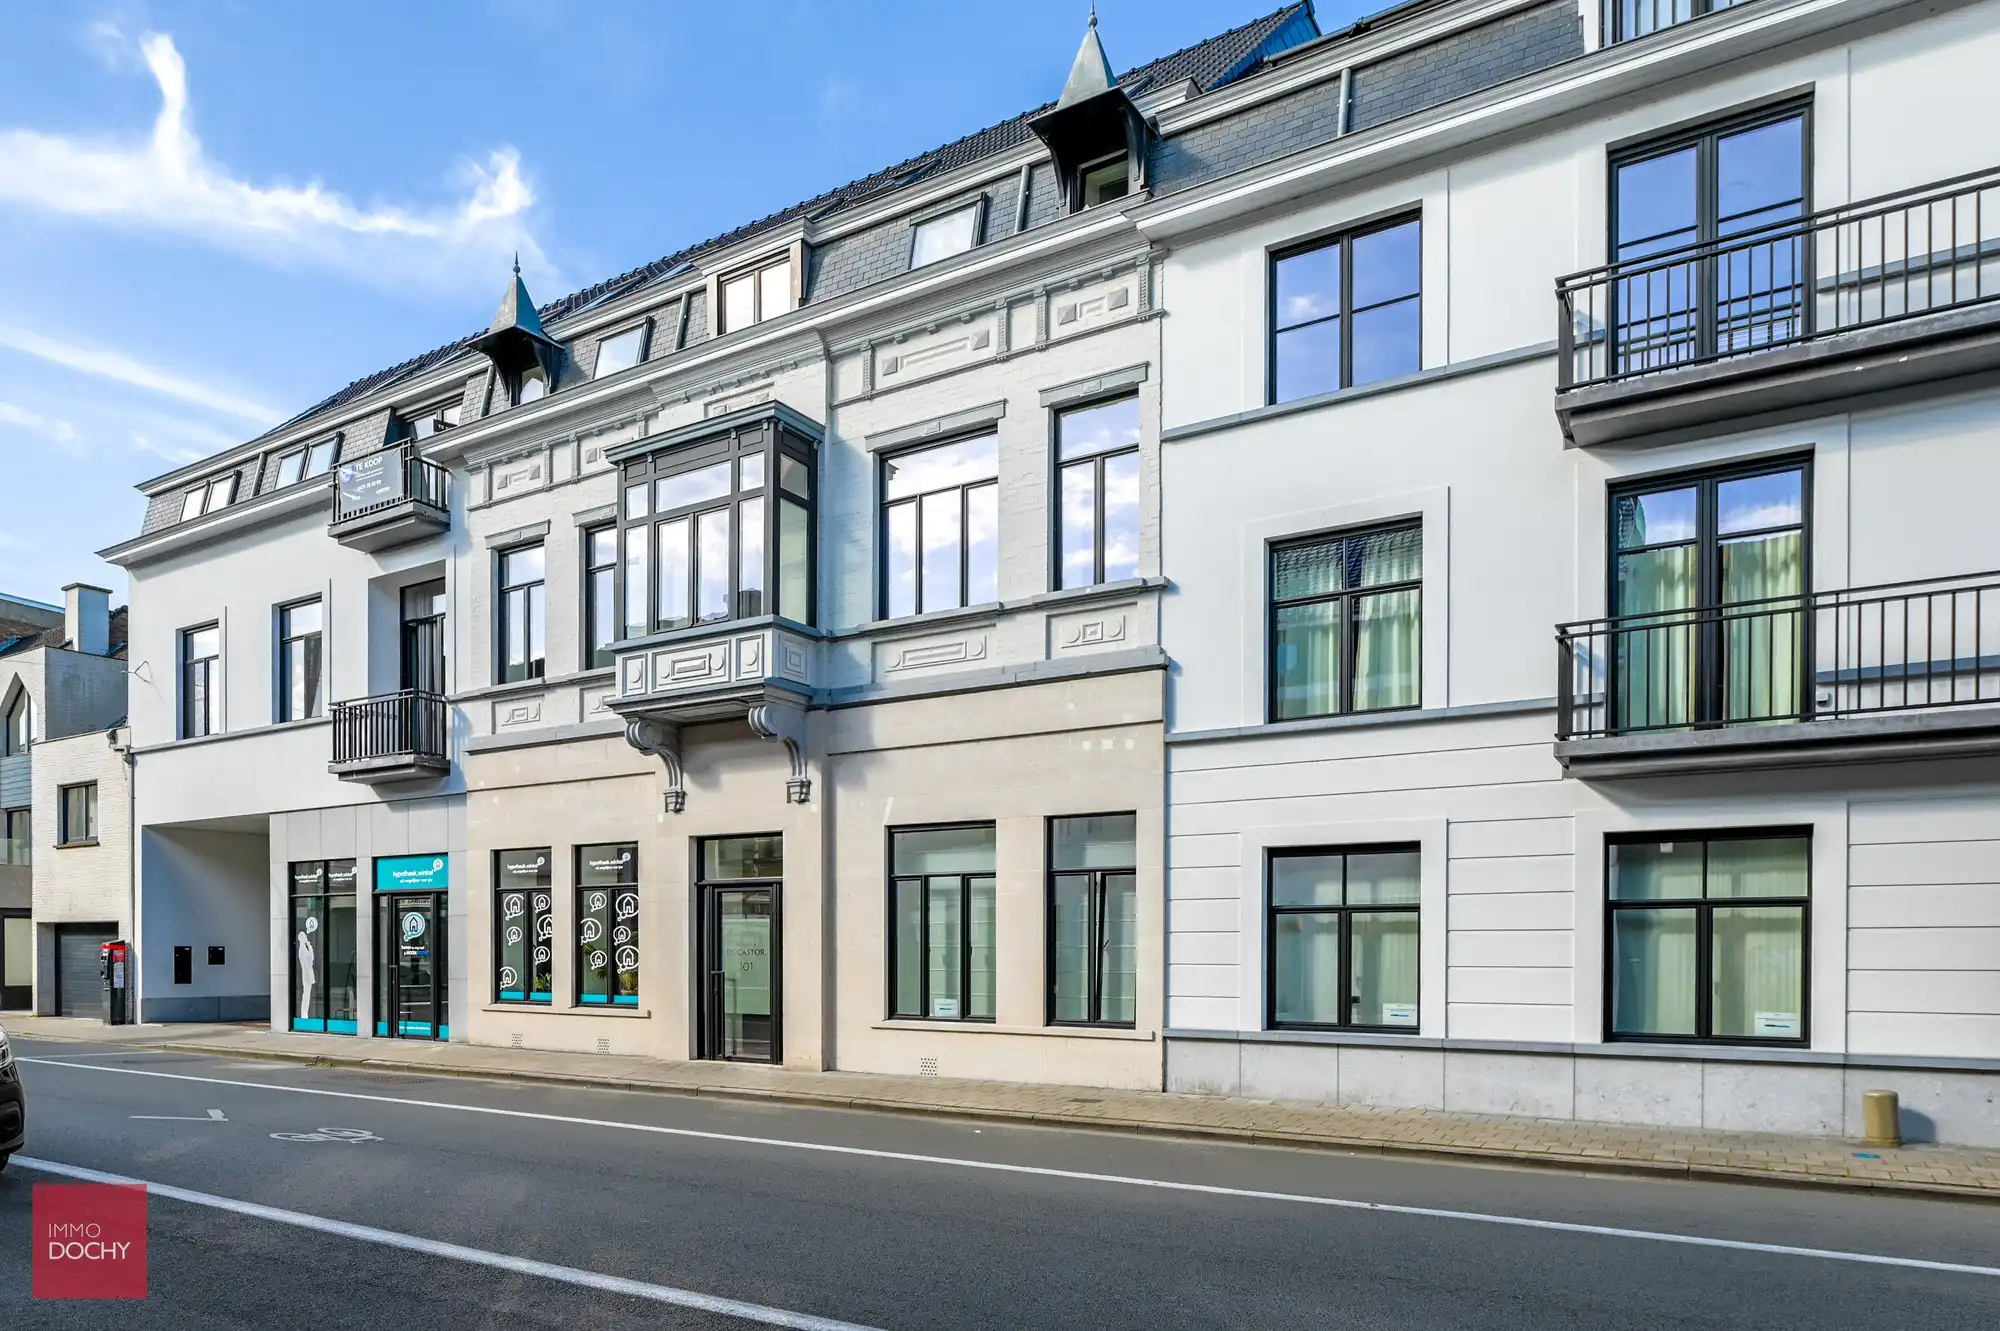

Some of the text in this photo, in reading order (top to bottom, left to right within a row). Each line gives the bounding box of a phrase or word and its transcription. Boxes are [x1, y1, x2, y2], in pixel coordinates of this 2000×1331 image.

[355, 456, 383, 471] TE KOOP
[740, 961, 753, 972] 101
